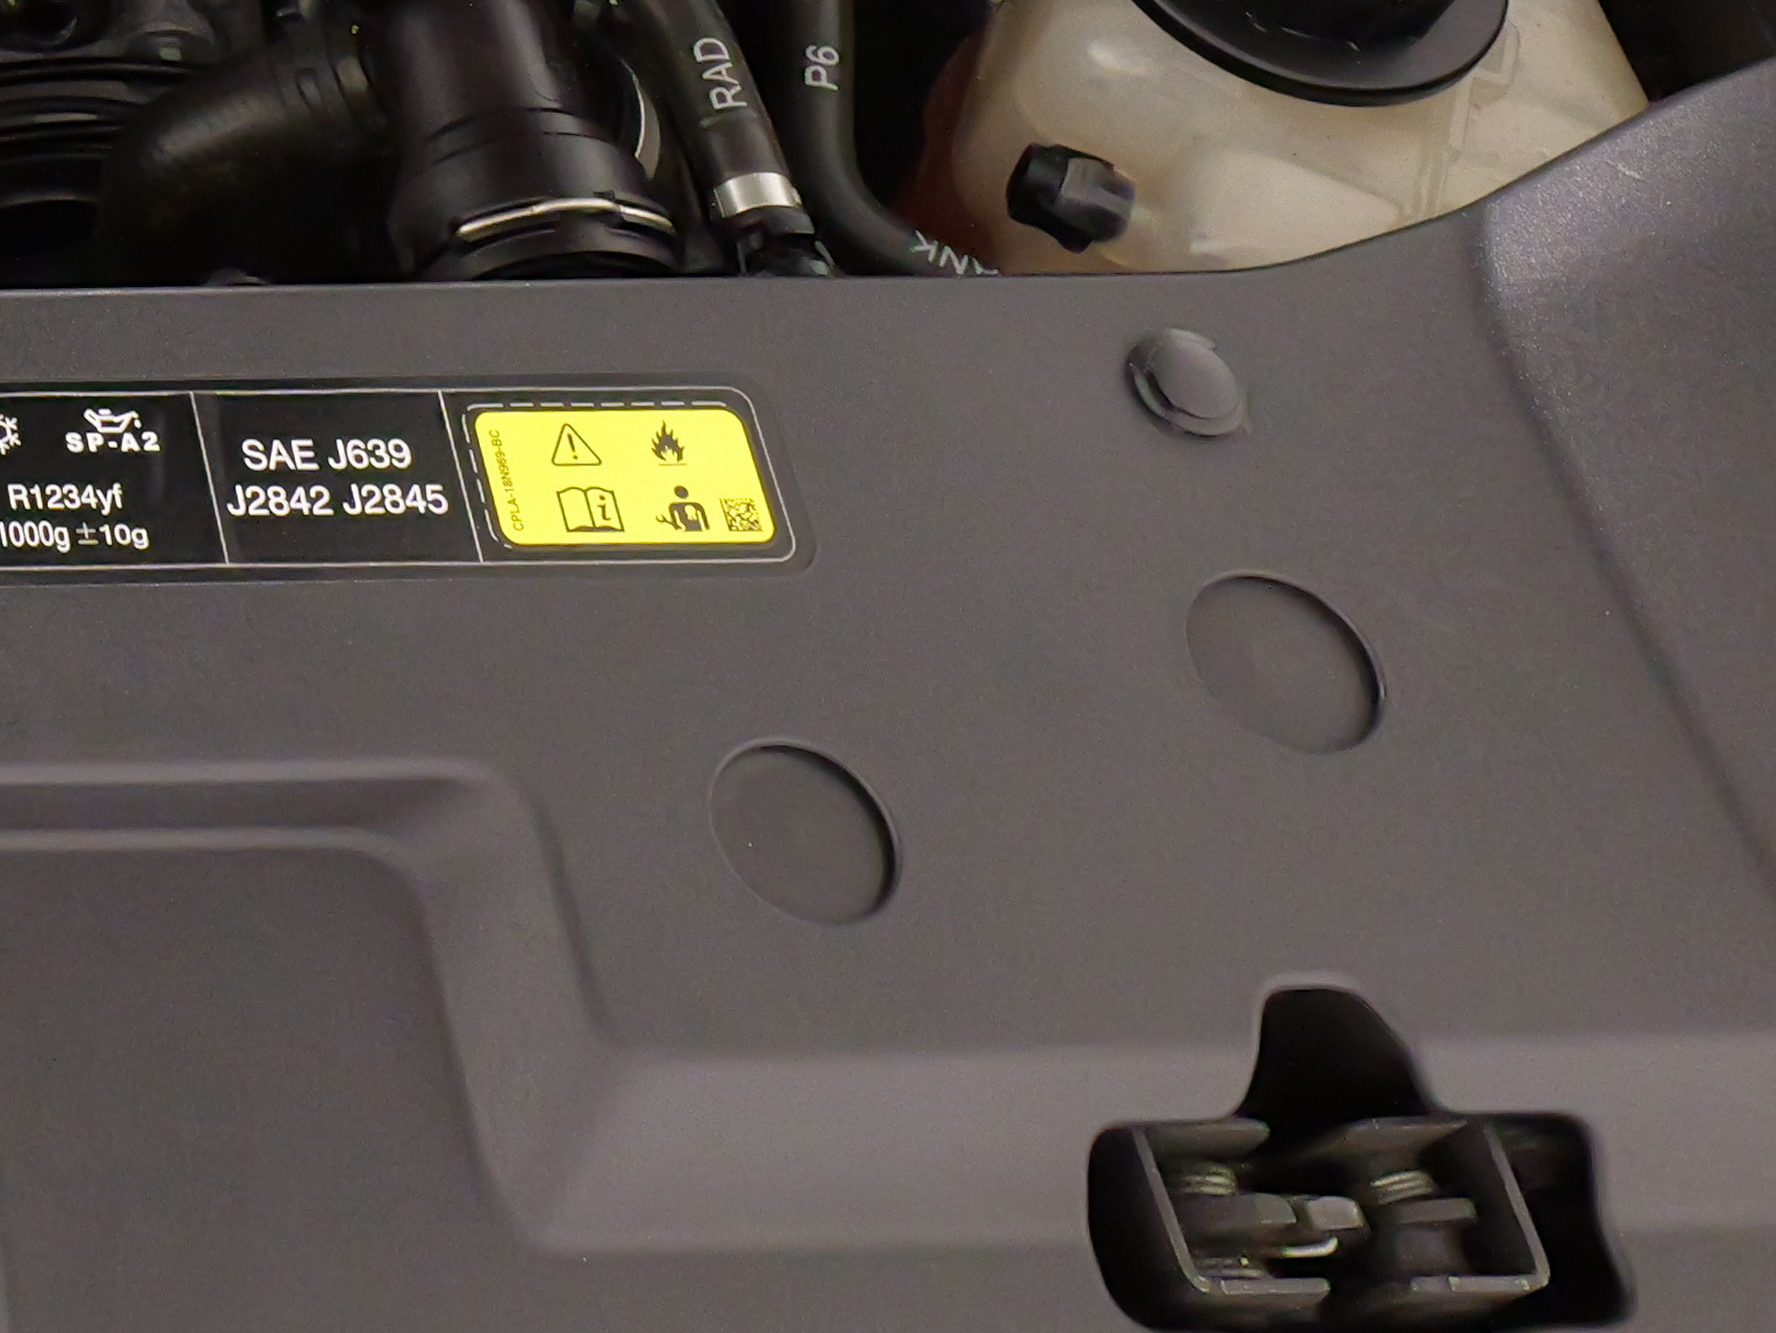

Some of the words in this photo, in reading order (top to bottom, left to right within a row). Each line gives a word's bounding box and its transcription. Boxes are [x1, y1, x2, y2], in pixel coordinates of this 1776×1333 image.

[693, 37, 748, 110] RAD
[804, 44, 840, 91] P6
[66, 431, 160, 453] SP-A2
[241, 439, 319, 472] SAE
[329, 437, 412, 471] J639
[7, 483, 123, 515] R1234yf
[227, 486, 333, 518] J2842
[343, 484, 449, 515] J2845
